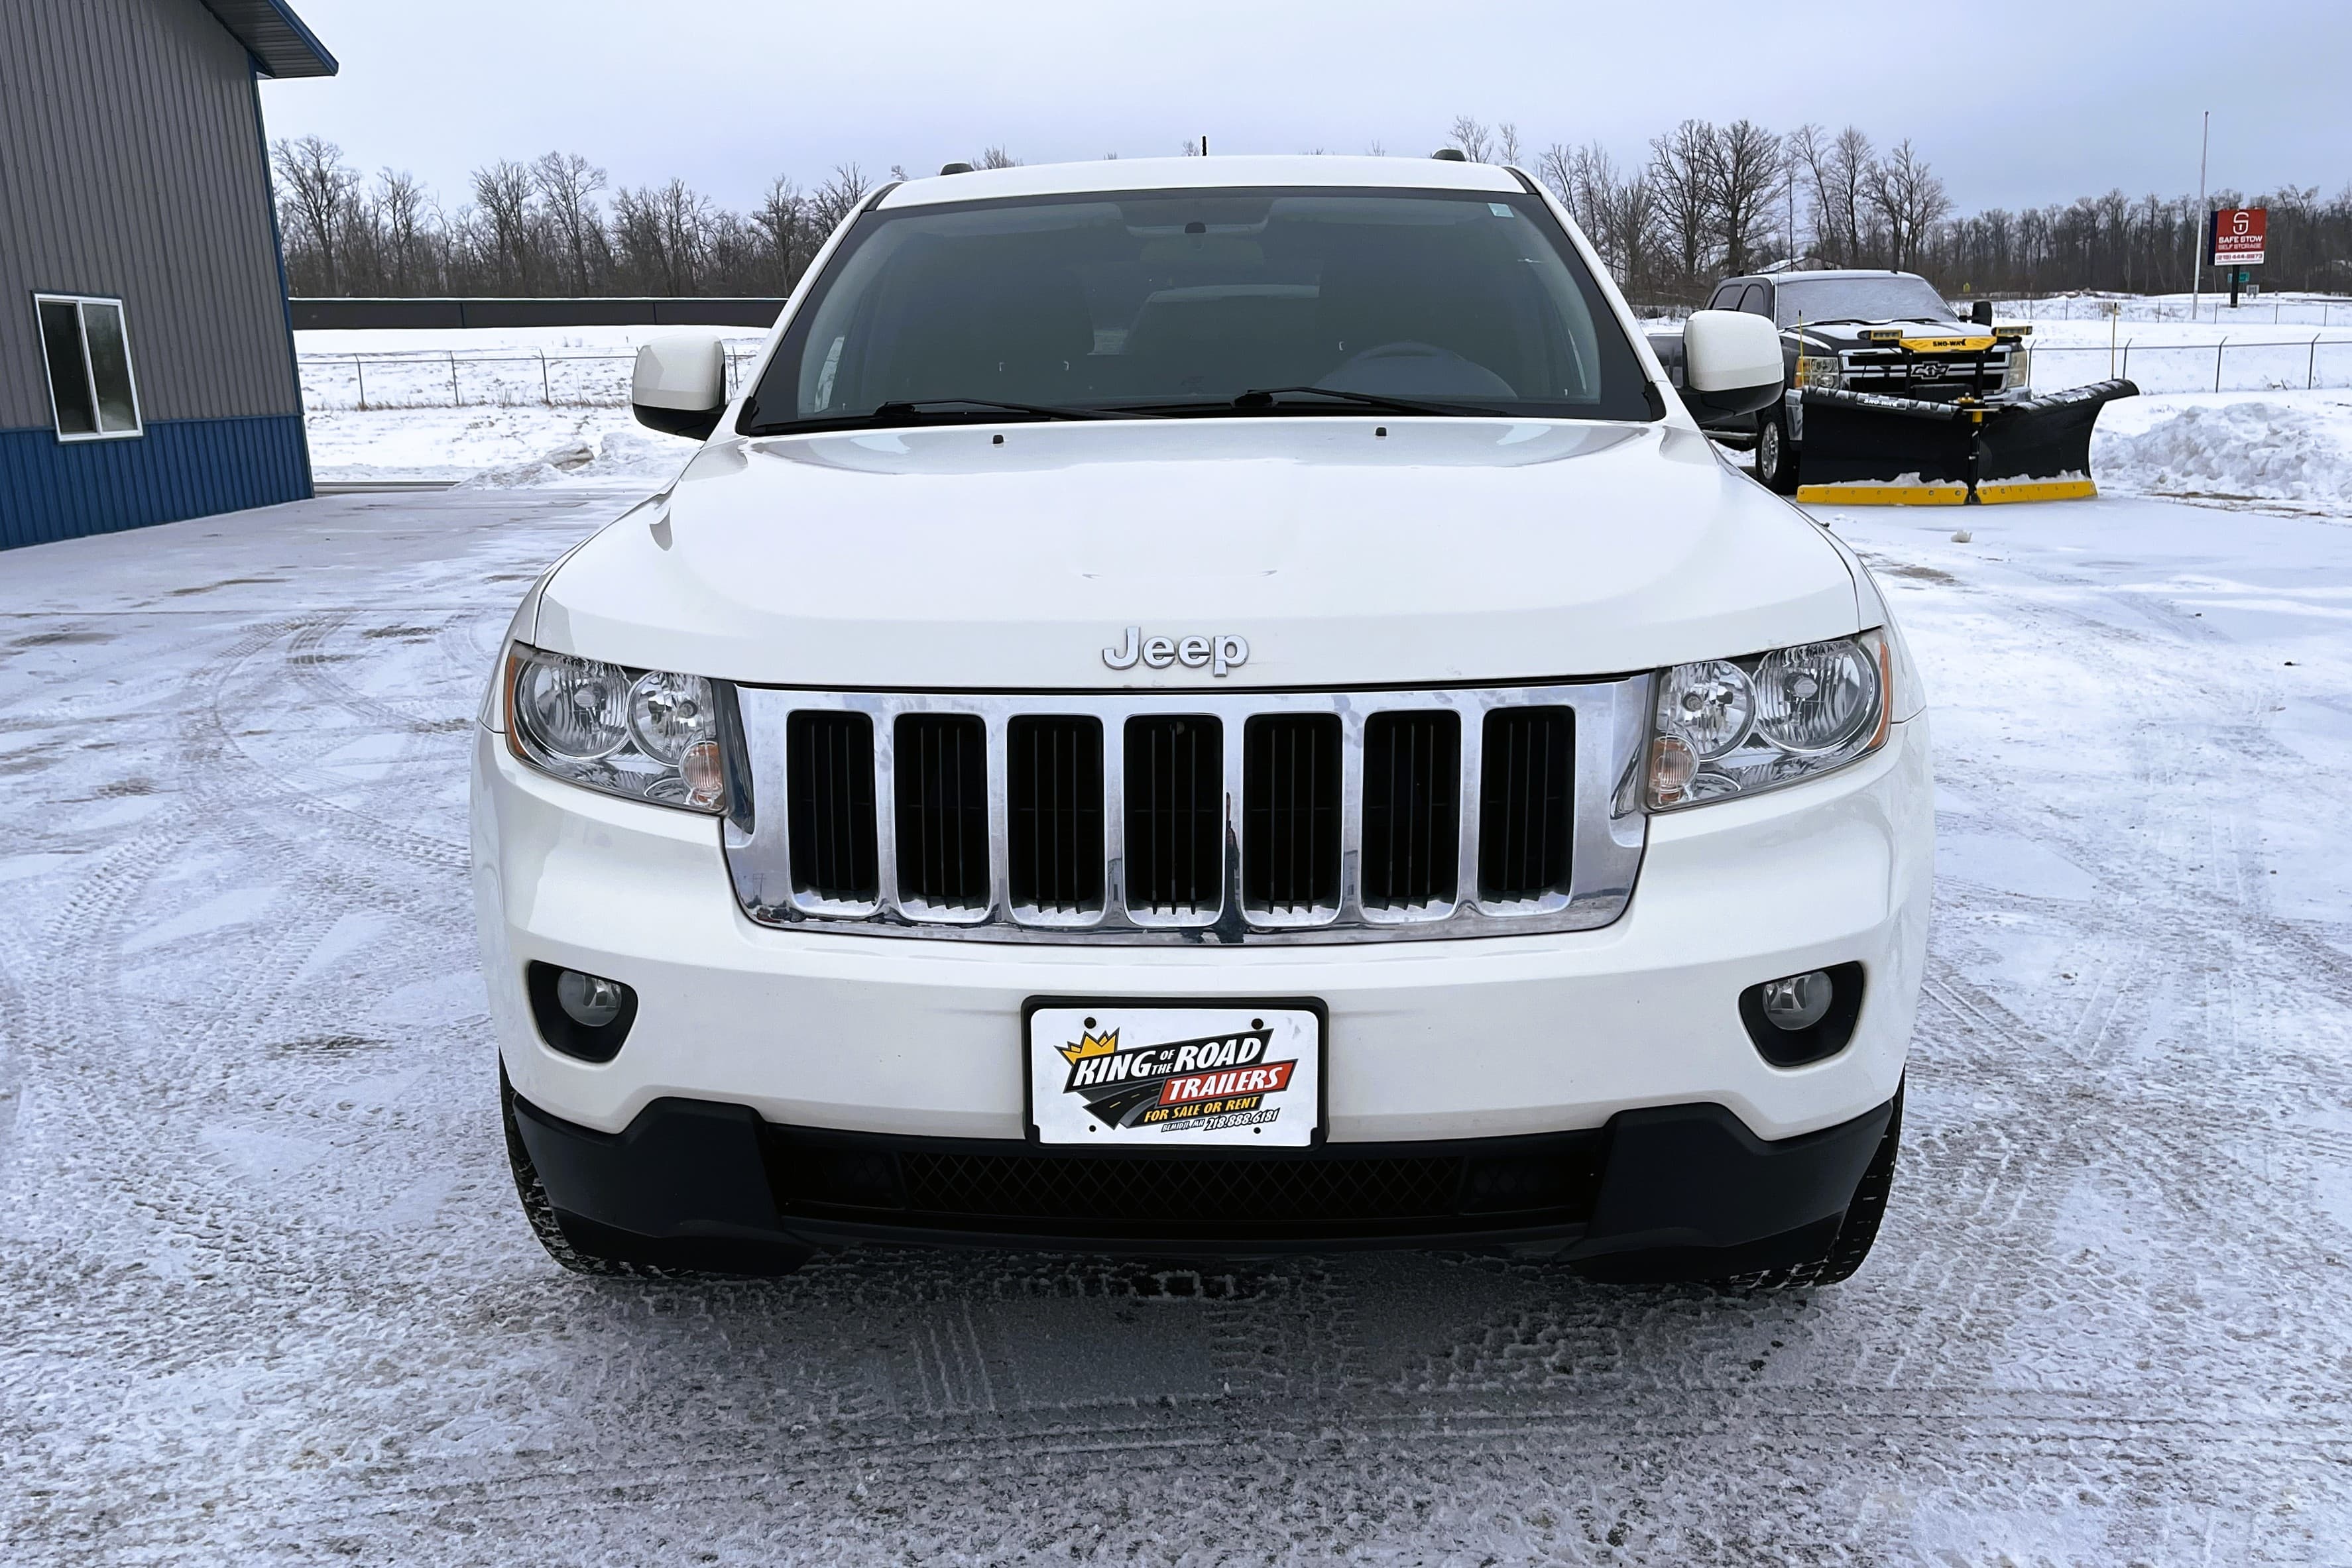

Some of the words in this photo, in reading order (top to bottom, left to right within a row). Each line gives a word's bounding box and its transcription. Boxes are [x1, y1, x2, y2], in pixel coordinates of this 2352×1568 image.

[1102, 626, 1249, 677] Jeep
[1072, 1050, 1157, 1087] KING
[1151, 1063, 1172, 1075] THE
[1159, 1050, 1176, 1061] OF
[1173, 1037, 1262, 1073] ROAD
[1168, 1067, 1283, 1101] TRAILERS
[1144, 1107, 1169, 1123] FOR
[1171, 1103, 1201, 1119] SALE
[1203, 1101, 1222, 1114] OR
[1225, 1096, 1260, 1111] RENT
[1193, 1119, 1205, 1128] MN
[1205, 1110, 1279, 1130] 218.888.6181
